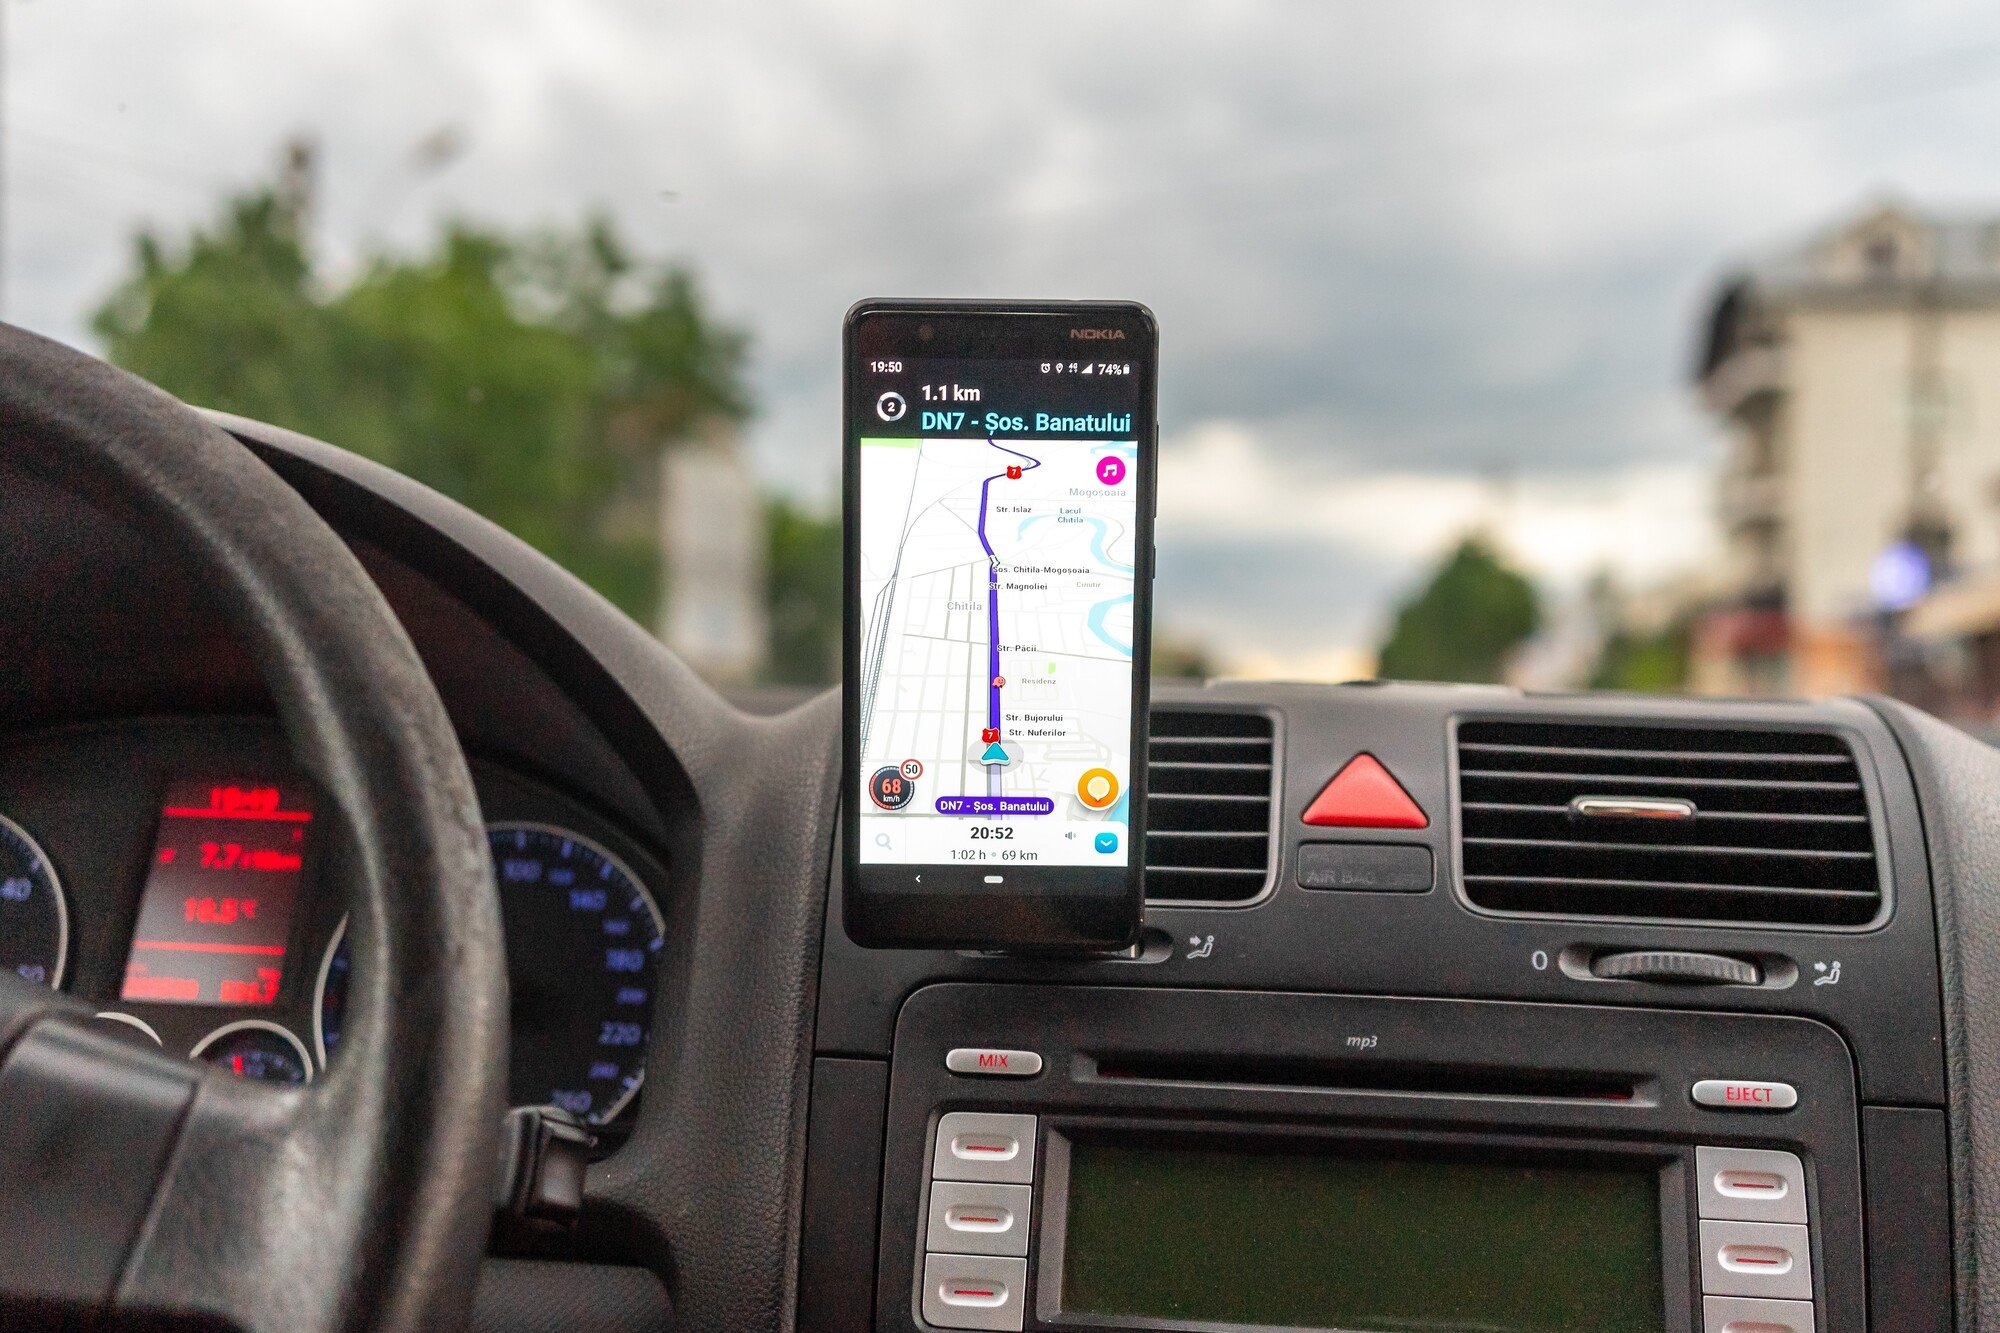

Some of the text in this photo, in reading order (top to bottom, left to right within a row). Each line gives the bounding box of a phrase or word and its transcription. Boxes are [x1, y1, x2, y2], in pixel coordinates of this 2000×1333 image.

[1069, 328, 1126, 340] NOKIA
[870, 361, 903, 373] 19:50
[1098, 363, 1122, 375] 74%
[921, 384, 980, 401] 1.1 km
[887, 402, 895, 412] 2
[921, 411, 965, 431] DN7
[1035, 412, 1132, 433] Banatului
[996, 505, 1032, 513] Str. Islaz
[1058, 516, 1084, 524] Chitila
[989, 582, 1048, 591] Str. Magnoliei
[947, 601, 982, 611] Chitila
[997, 644, 1012, 652] Str.
[1005, 714, 1063, 723] Str. Bujorului
[1009, 729, 1066, 737] Str. Nuferilor
[905, 764, 918, 775] 50
[881, 779, 901, 794] 68
[883, 794, 900, 802] km/h
[940, 800, 963, 811] DN7
[999, 801, 1049, 812] Banatului
[970, 827, 1014, 840] 20:52
[951, 849, 1038, 860] 1:02 h 69 km
[1346, 1034, 1378, 1050] mp3
[978, 1053, 1008, 1068] MIX
[1725, 1086, 1773, 1103] EJECT
